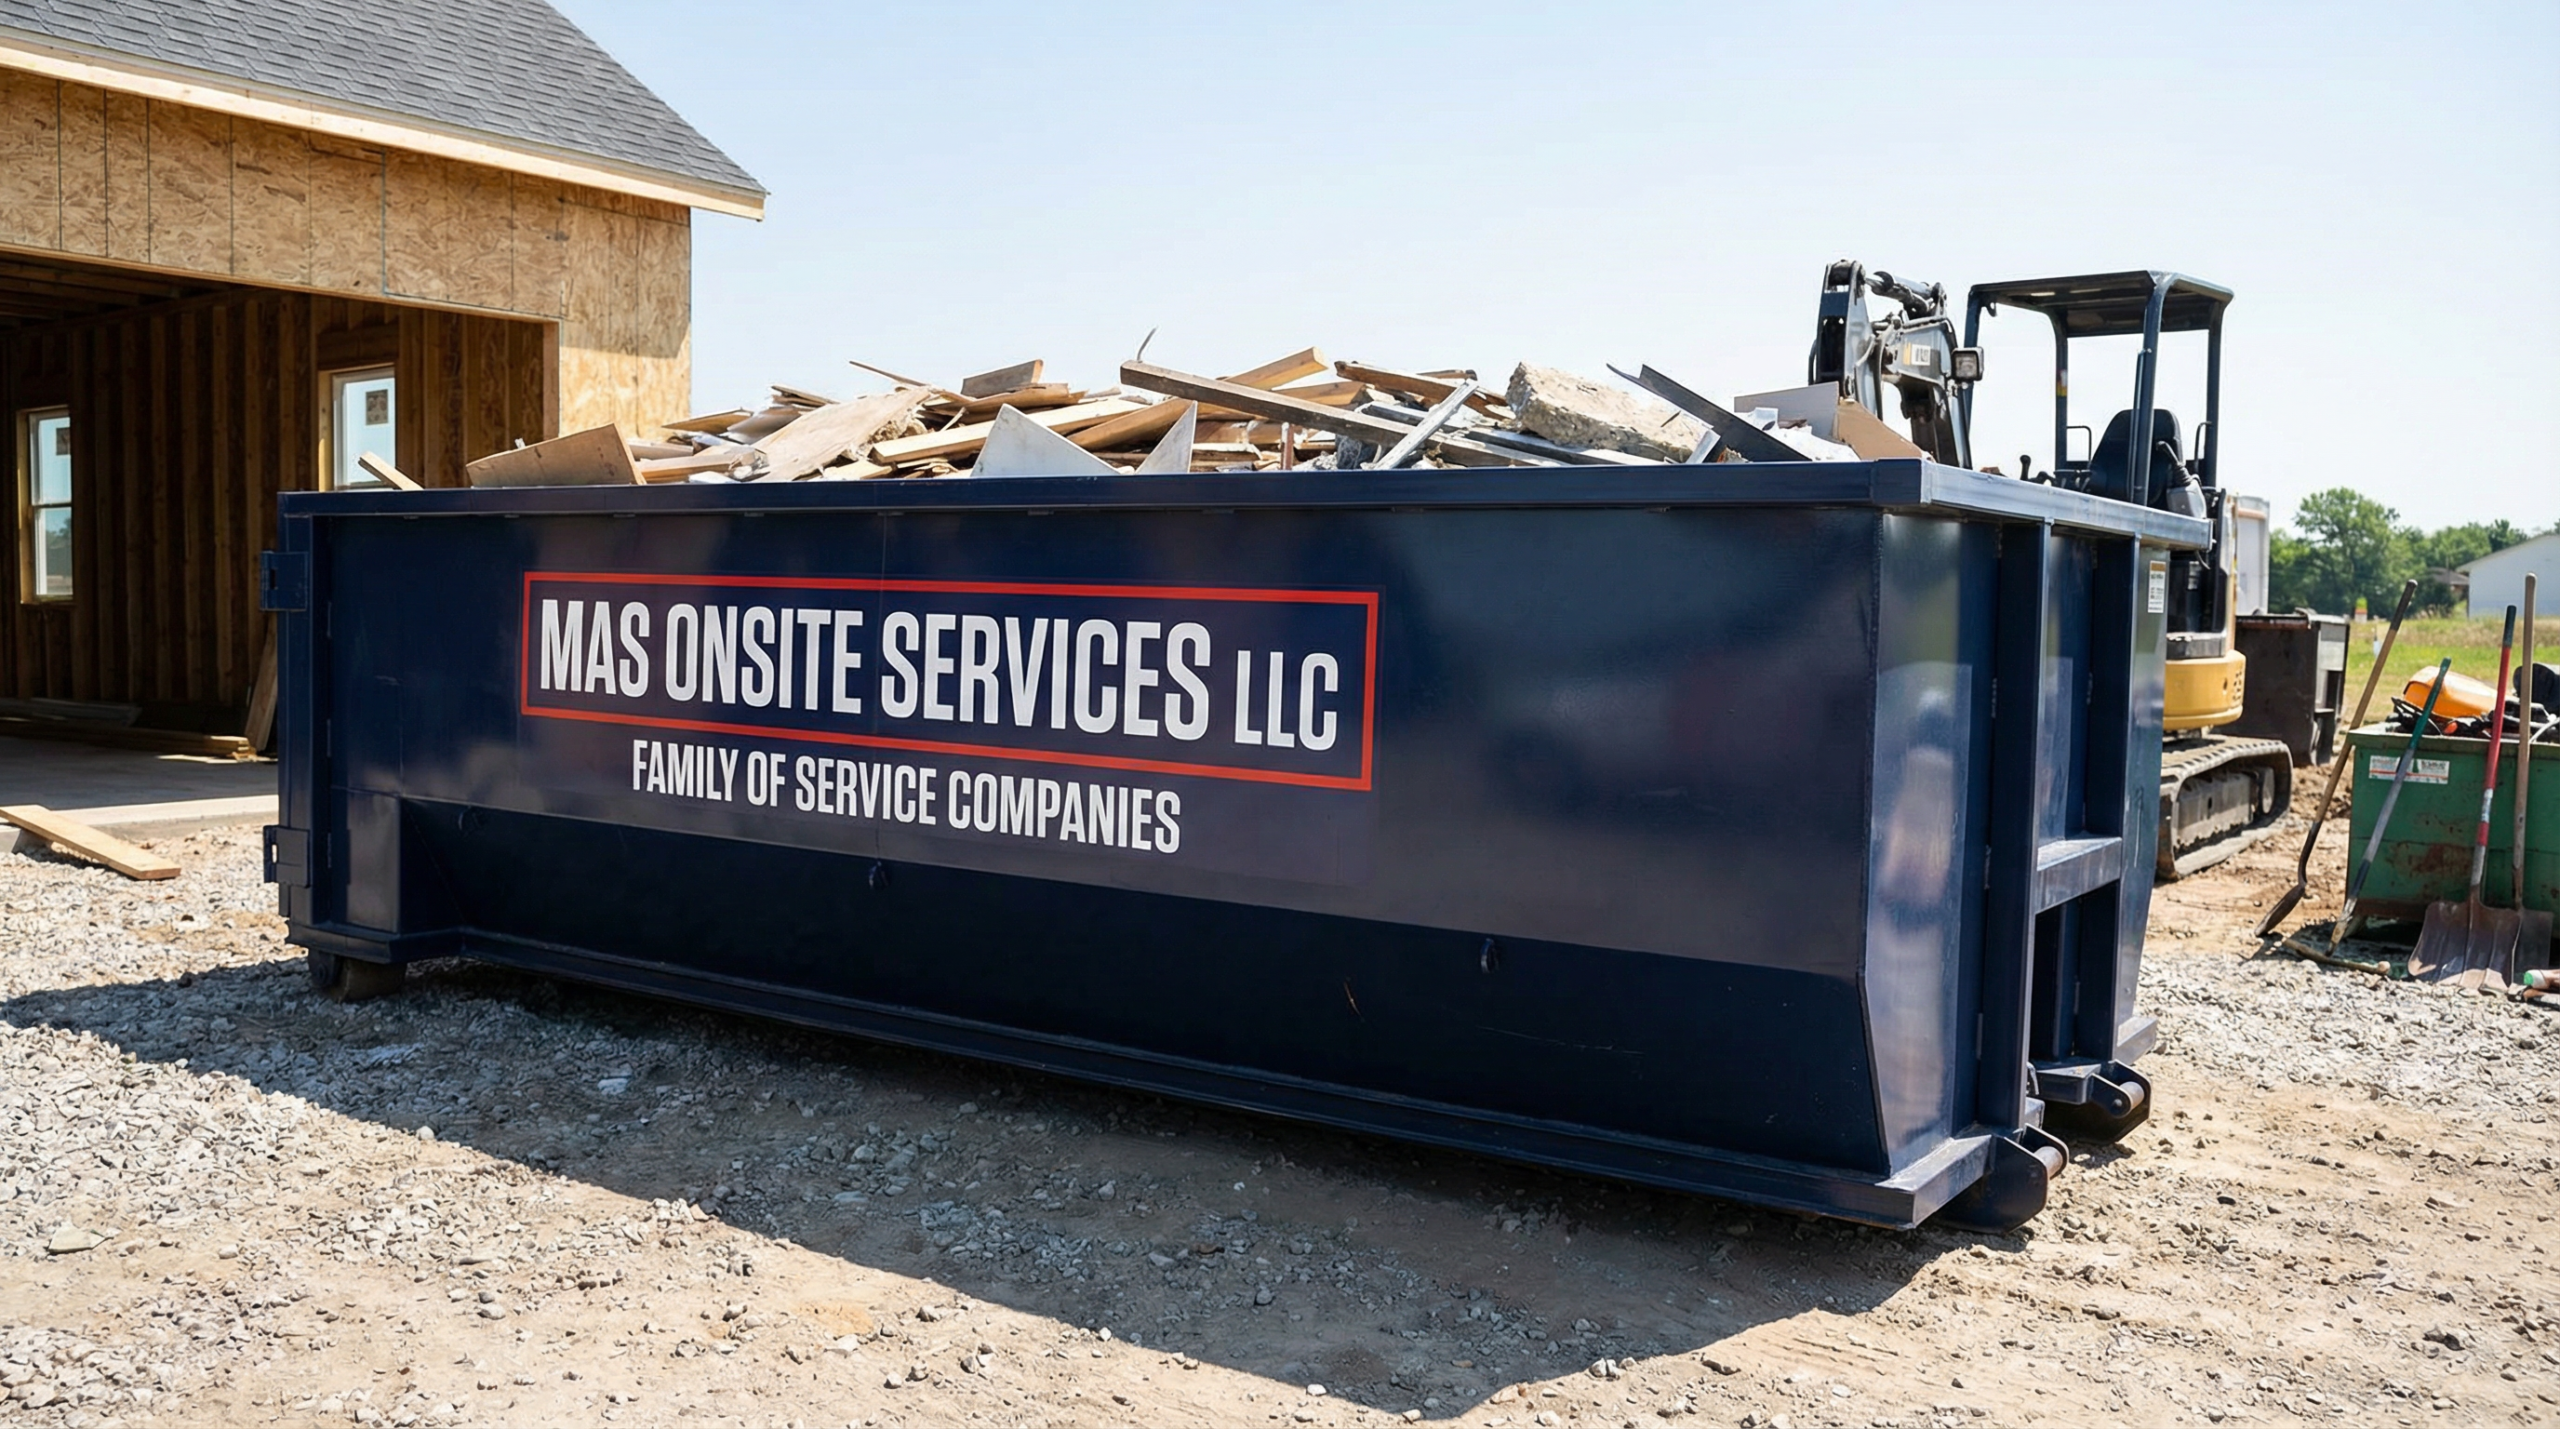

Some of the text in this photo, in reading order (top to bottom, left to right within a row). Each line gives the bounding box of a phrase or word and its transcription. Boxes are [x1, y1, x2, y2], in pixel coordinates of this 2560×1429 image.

[540, 598, 1339, 751] MAS ONSITE SERVICES LLC
[632, 739, 1181, 854] FAMILY OF SERVICE COMPANIES
